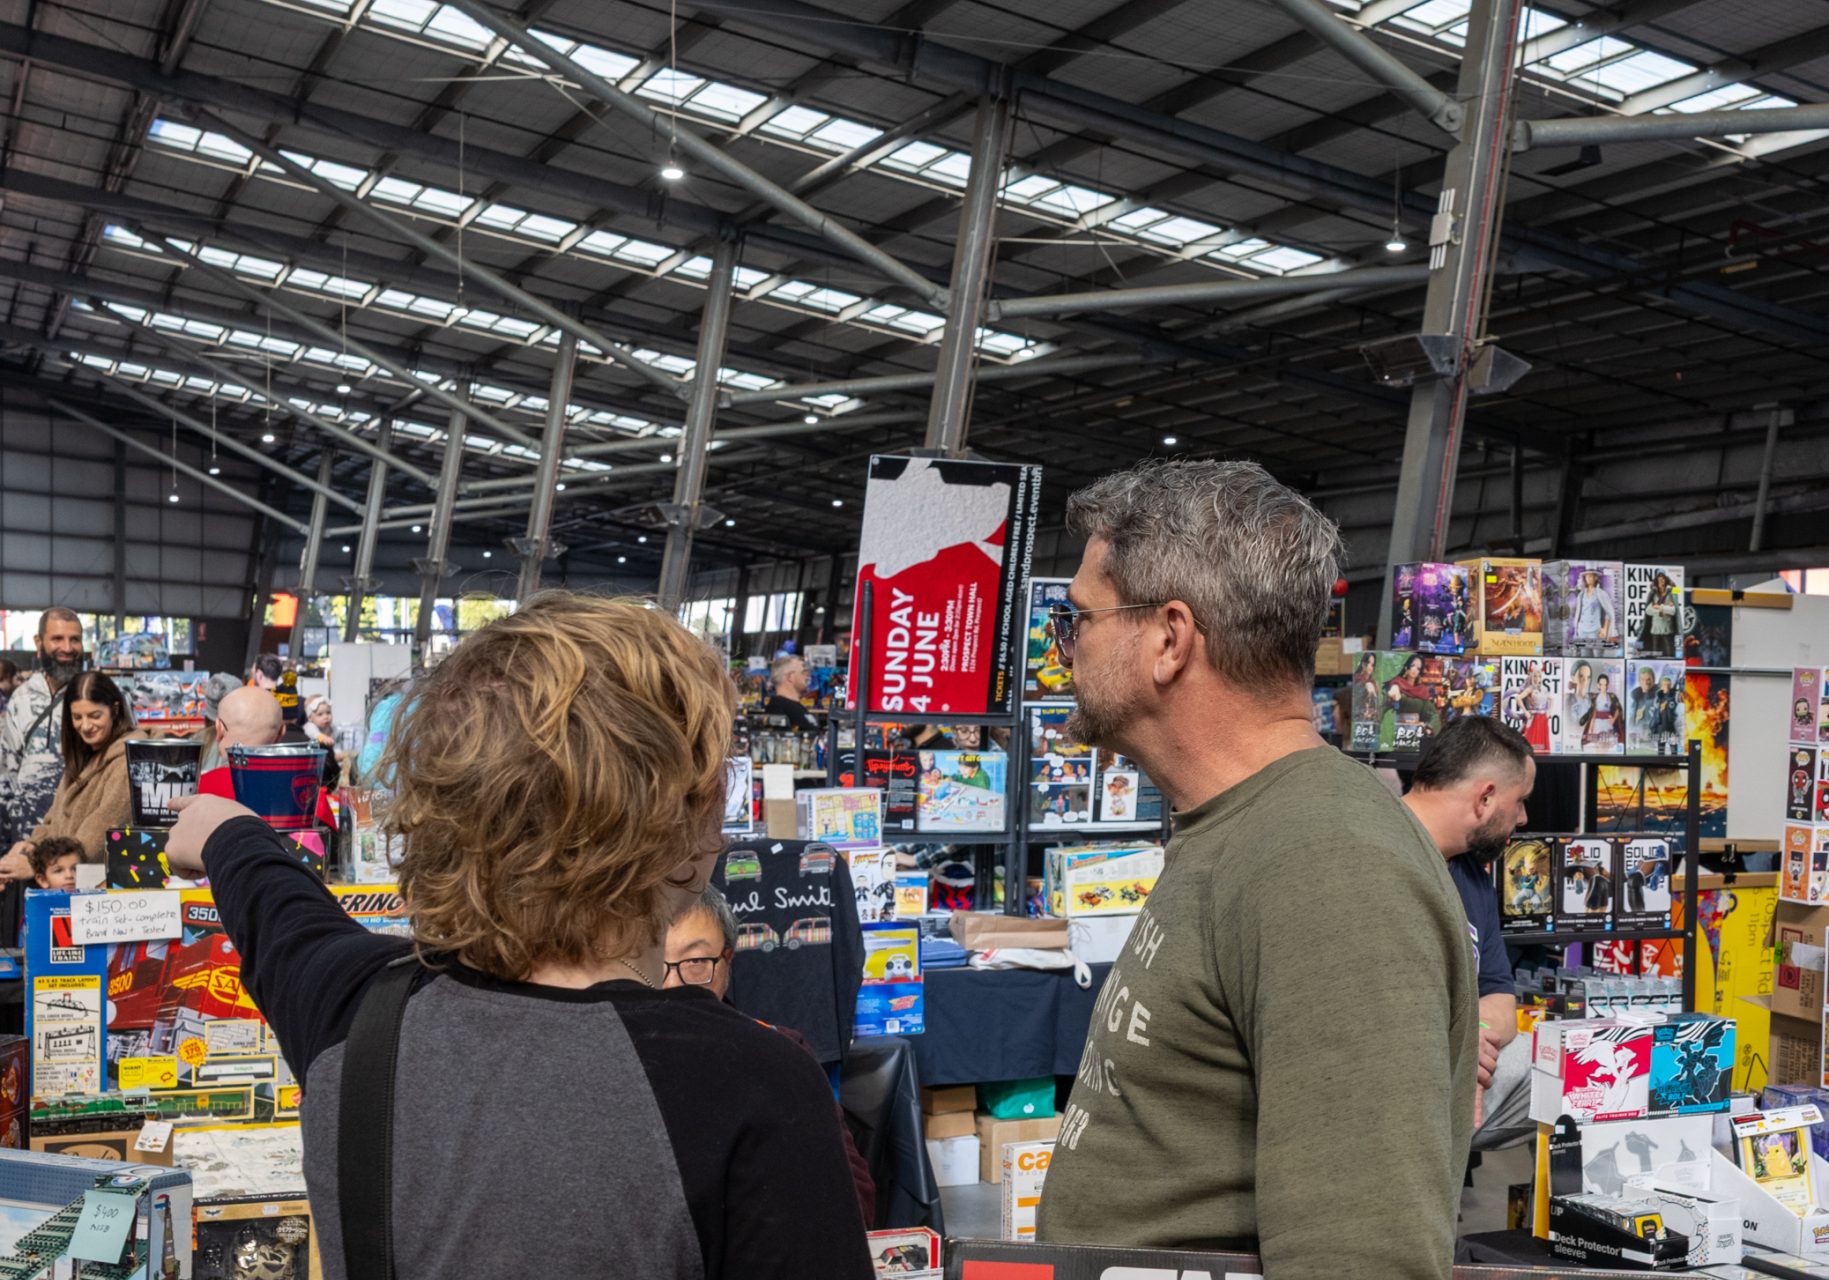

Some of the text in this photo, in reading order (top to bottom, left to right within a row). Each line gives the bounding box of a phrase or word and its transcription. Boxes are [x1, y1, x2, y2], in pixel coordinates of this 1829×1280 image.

[1016, 481, 1026, 514] LIMITED
[1013, 520, 1022, 540] FREE
[1008, 541, 1019, 580] CHILDREN
[1005, 582, 1014, 607] AGED
[1628, 584, 1647, 599] OF
[944, 600, 955, 633] 3:30PM
[961, 582, 978, 673] PROSPECT TOWN HALL
[1002, 608, 1012, 638] SCHOOL
[882, 587, 914, 712] SUNDAY
[909, 611, 940, 713] 4 JUNE
[940, 640, 951, 672] 2:30PM
[995, 671, 1005, 702] TICKETS
[1505, 678, 1560, 694] ARST
[1566, 847, 1600, 858] SLID
[85, 898, 148, 915] $150.00
[188, 906, 222, 921] 350
[334, 893, 401, 912] ERING
[79, 914, 109, 925] train
[135, 909, 177, 923] complete
[1747, 912, 1760, 947] 11pm
[108, 971, 133, 997] 3500
[1757, 971, 1773, 995] Rd
[1018, 1151, 1053, 1171] ca
[1550, 1205, 1564, 1216] UP
[1554, 1230, 1620, 1257] Deck Protector
[1554, 1243, 1587, 1260] sleeves
